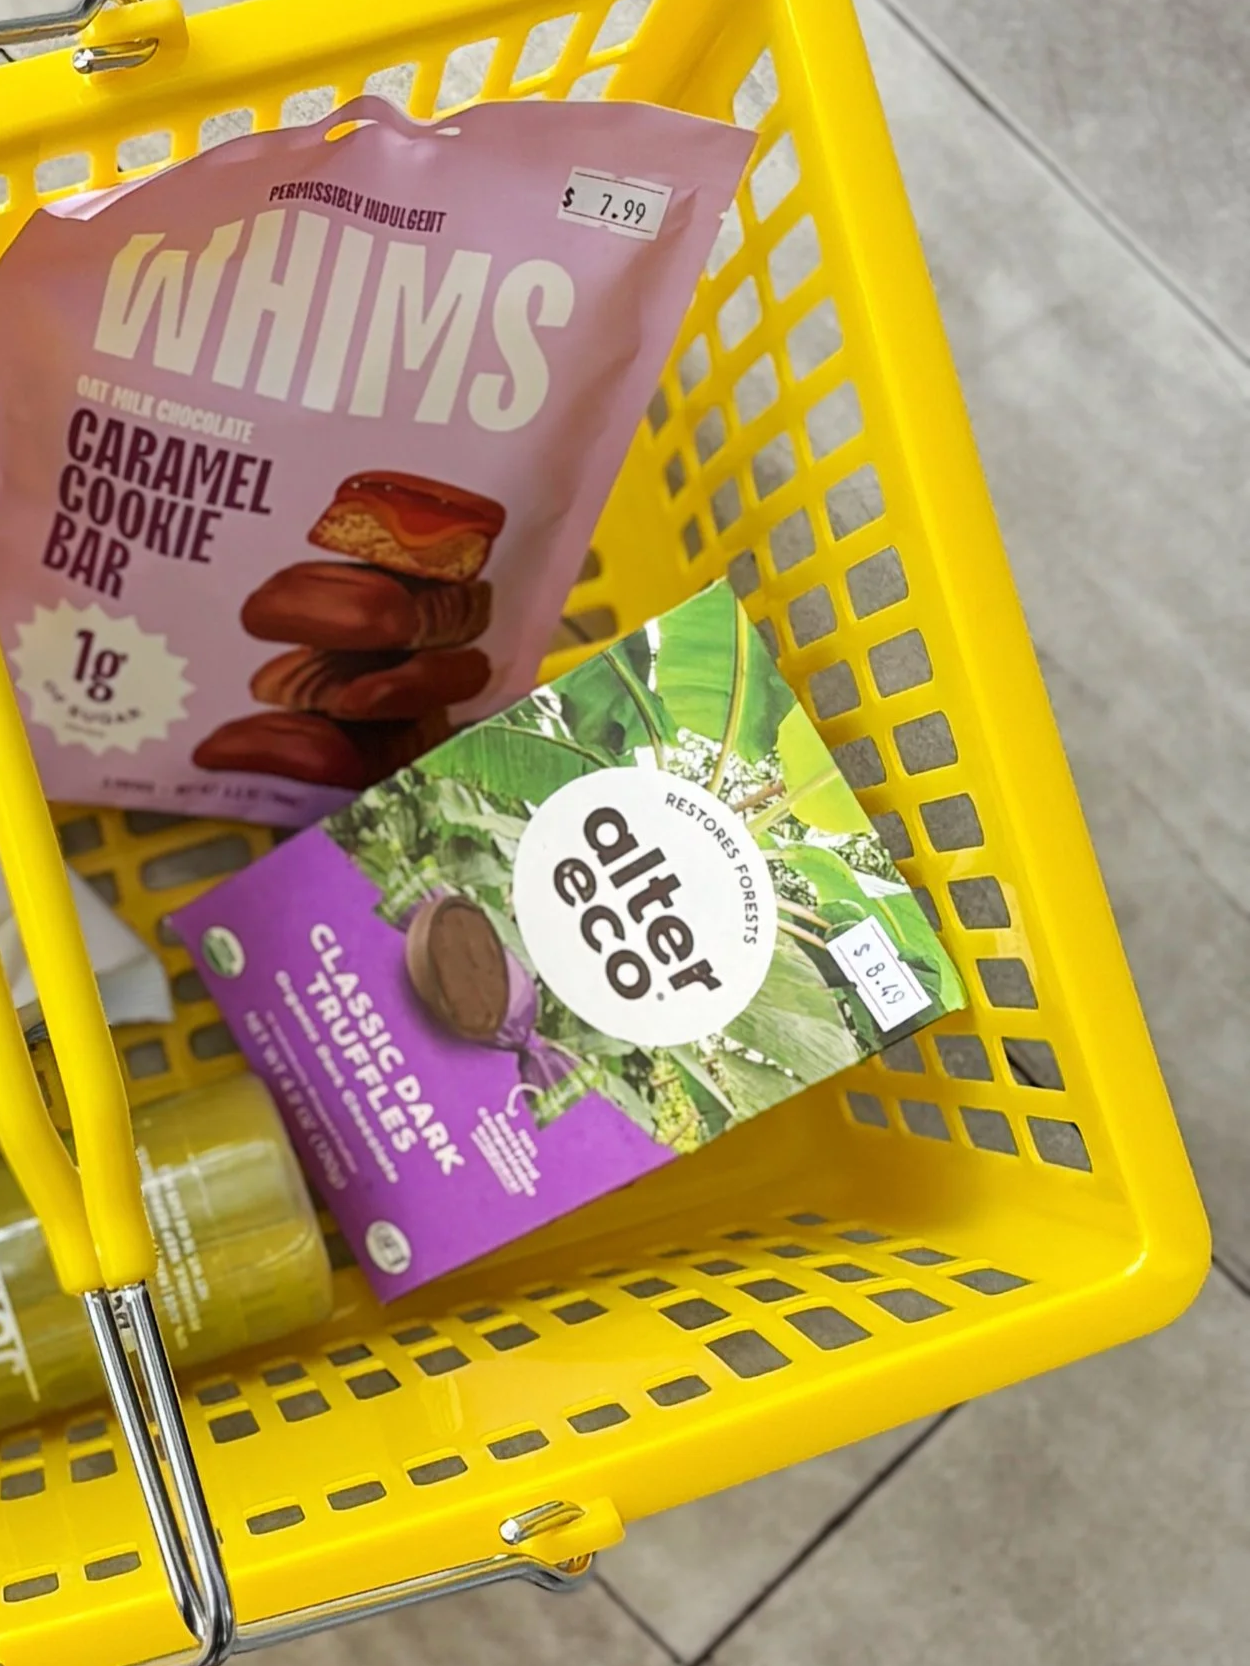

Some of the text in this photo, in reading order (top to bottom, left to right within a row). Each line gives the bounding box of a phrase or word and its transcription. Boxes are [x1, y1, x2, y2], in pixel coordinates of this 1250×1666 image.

[269, 180, 447, 233] PERMISSIBLY INDULGENT
[562, 186, 647, 226] $ 7.99
[93, 208, 575, 433] WHIMS
[67, 408, 273, 516] CARAMEL
[76, 374, 254, 445] OAT MILK CHOCOLATE
[41, 510, 132, 599] BAR
[57, 463, 223, 564] COOKIE
[73, 629, 128, 702] 1g
[583, 807, 722, 993] alter
[665, 792, 759, 945] RESTORES FORESTS
[553, 857, 651, 1001] eco
[853, 942, 906, 1006] $ 8.49
[274, 969, 320, 1045] Organic
[316, 1043, 347, 1090] Dark
[341, 1089, 399, 1184] Chocolate
[306, 973, 418, 1153] TRUFFLES
[310, 923, 405, 1076] CLASSIC
[395, 1075, 465, 1175] DARK
